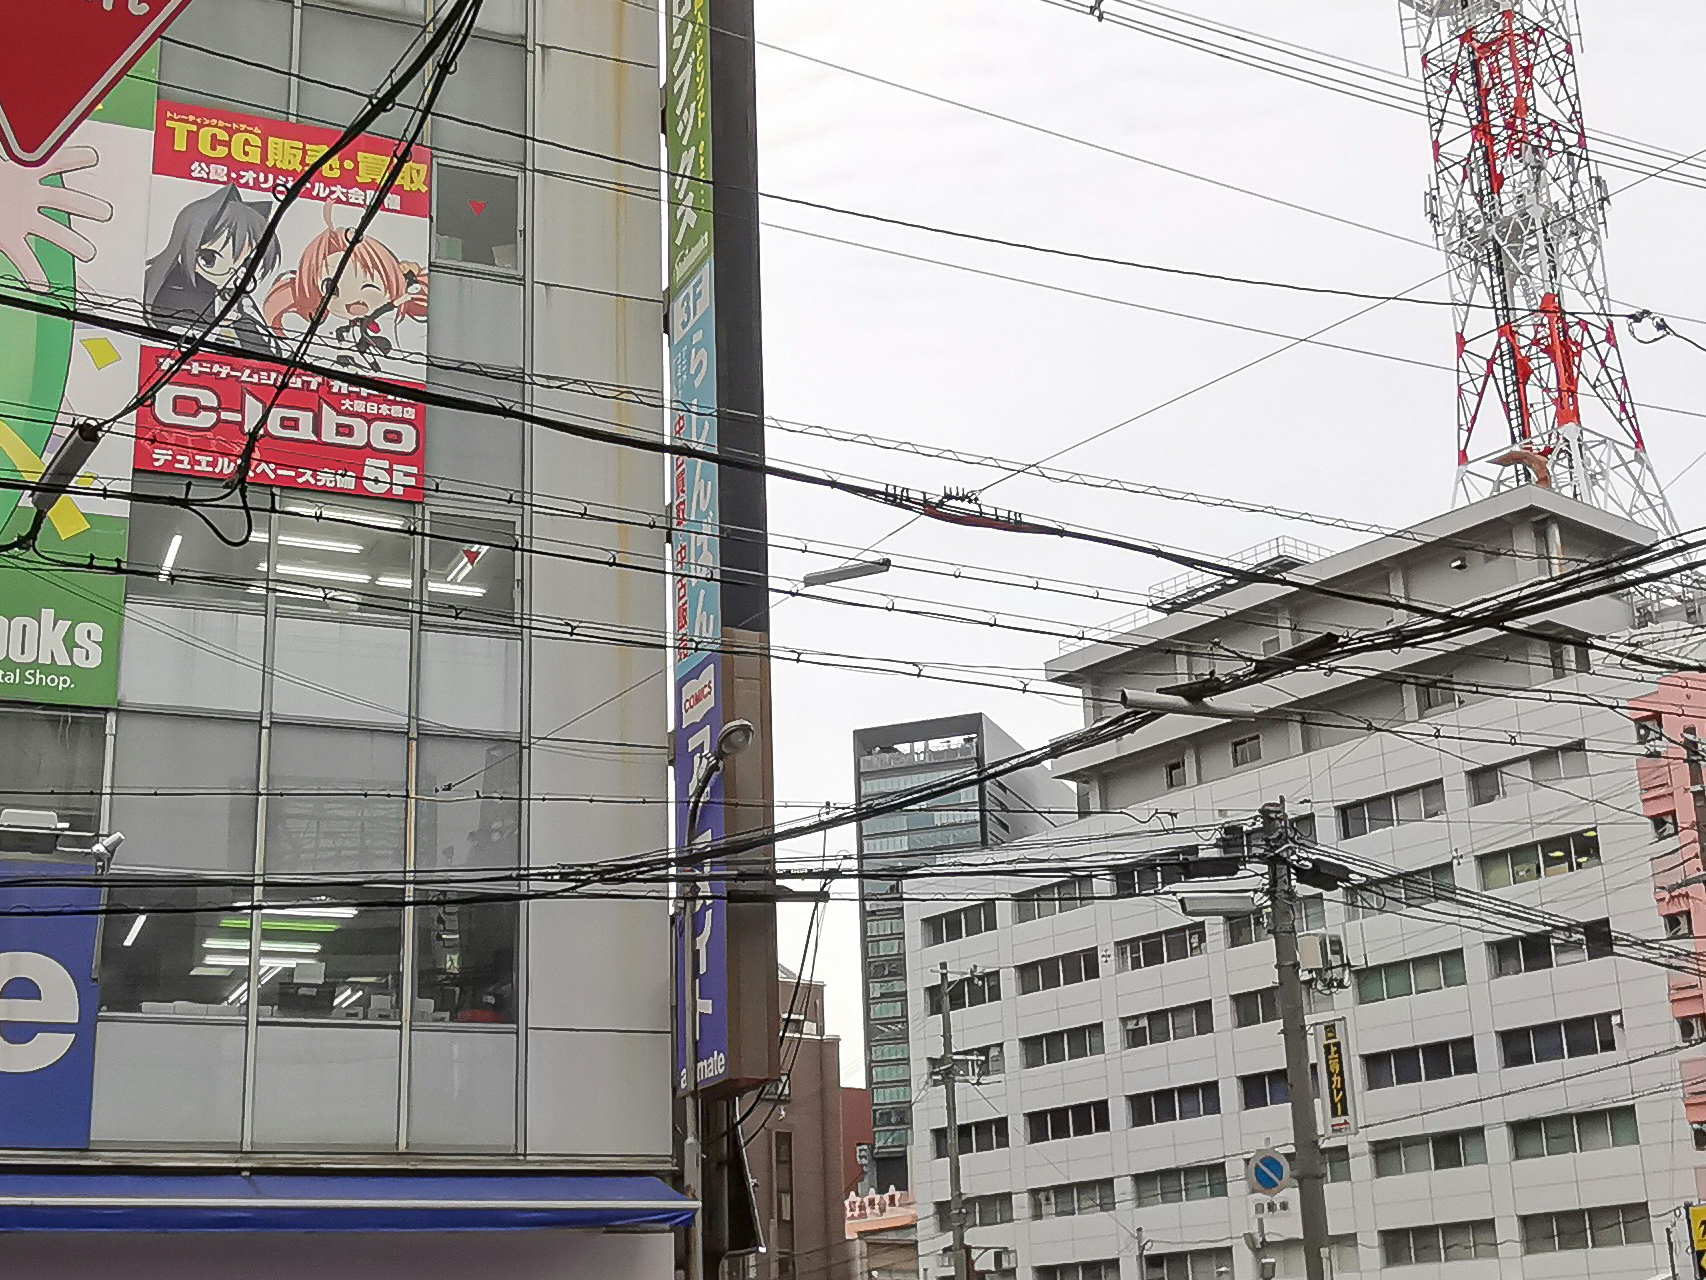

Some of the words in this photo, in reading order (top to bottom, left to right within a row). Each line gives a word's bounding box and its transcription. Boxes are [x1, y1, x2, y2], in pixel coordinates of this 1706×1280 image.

[679, 274, 704, 332] 3F
[153, 383, 419, 456] C-labo
[362, 457, 419, 497] 5F
[23, 669, 76, 691] Shop.
[683, 686, 713, 715] COMICS
